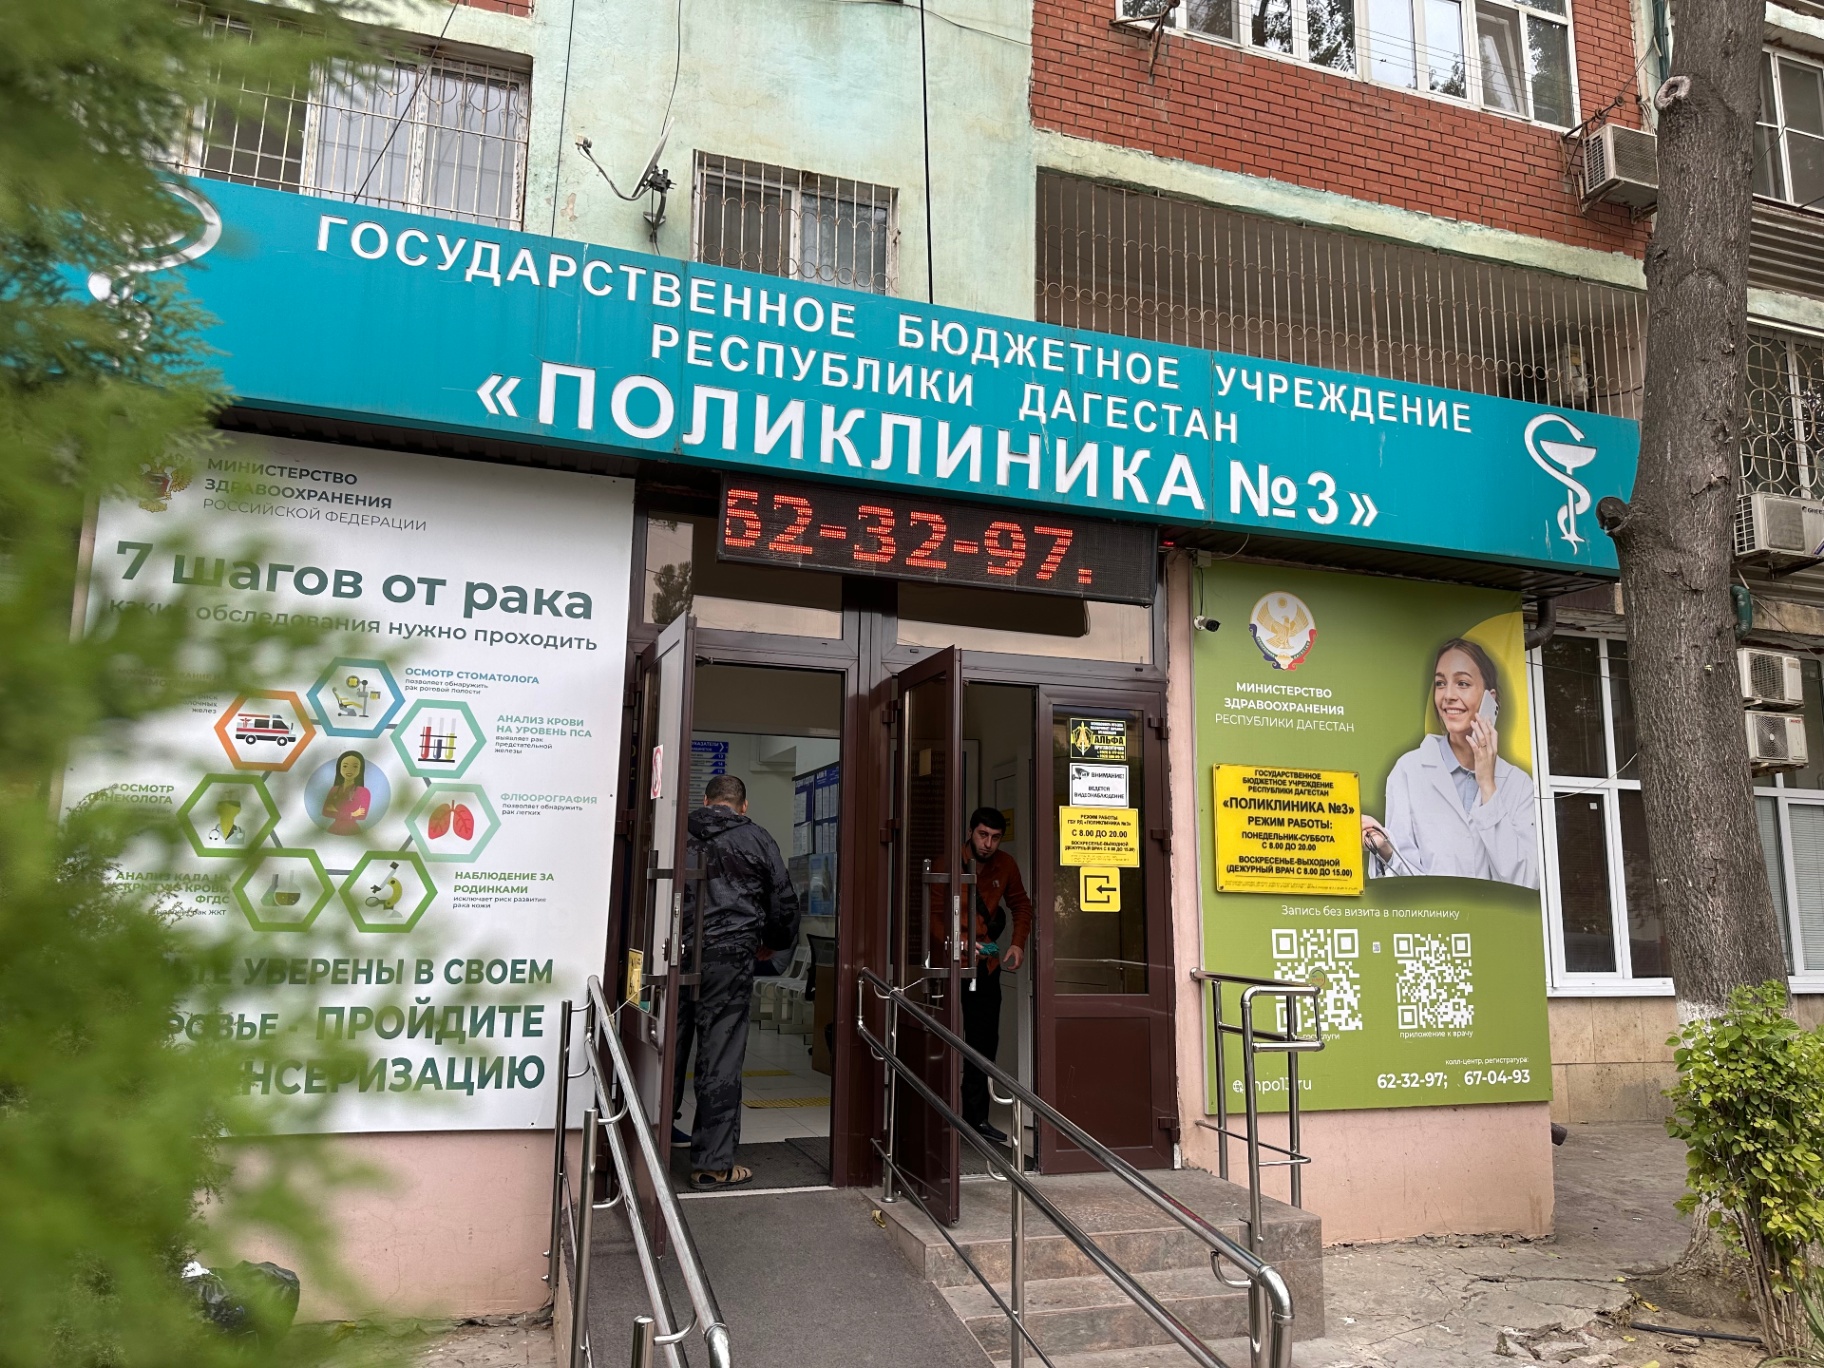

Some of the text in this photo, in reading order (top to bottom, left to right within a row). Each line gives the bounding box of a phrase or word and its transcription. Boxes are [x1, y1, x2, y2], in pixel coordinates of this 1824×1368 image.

[317, 213, 1473, 434] ГОСУДАРСТВЕННОЕ БЮДЖЕТНОЕ УЧРЕЖДЕНИЕ
[651, 322, 1239, 445] РЕСПУБЛИКИ ДАГЕСТАН
[476, 361, 1206, 511] «ПОЛИКЛИНИКА
[207, 457, 358, 486] МИНИСТЕРСТВО
[204, 477, 392, 509] ЗДРАВООХРАНЕНИЯ
[203, 497, 428, 532] РОССИЙСКОЙ ФЕДЕРАЦИИ
[116, 539, 593, 620] 7 шагов от рака
[196, 603, 381, 634] обследования
[388, 621, 467, 640] нужно
[474, 628, 598, 651] проходить
[405, 667, 540, 684] ОСМОТР СТОМАТОЛОГА
[404, 684, 418, 692] рак
[1236, 681, 1332, 698] МИНИСТЕРСТВО
[1223, 697, 1345, 715] ЗДРАВООХРАНЕНИЯ
[497, 714, 584, 727] АНАЛИЗ КРОВИ
[1215, 713, 1355, 732] РЕСПУБЛИКИ ДАГЕСТАН
[496, 725, 592, 738] НА УРОВЕНЬ ПСА
[1094, 735, 1124, 745] АЛЬФА
[1254, 769, 1322, 780] ГОСУДАРСТВЕННОЕ
[120, 783, 175, 794] ОСМОТР
[1242, 777, 1334, 789] БЮДЖЕТНОЕ УЧРЕЖДЕНИЕ
[500, 792, 598, 804] ФЛЮОРОГРАФИЯ
[1248, 786, 1329, 797] РЕСПУБЛИКИ ДАГЕСТАН
[99, 793, 173, 804] НЕКОЛОГА
[1222, 796, 1355, 815] «ПОЛИКЛИНИКА №3»
[1247, 816, 1333, 829] РЕЖИМ РАБОТЫ:
[1071, 829, 1128, 838] С 8.00 ДО 20.00
[1241, 831, 1335, 843] ПОНЕДЕЛЬНИК-СУББОТА
[1261, 841, 1317, 851] С 8.00 ДО 20.00
[1238, 855, 1340, 867] ВОСКРЕСЕНЬЕ-ВЫХОДНОЙ
[115, 871, 171, 881] АНАЛИЗ
[454, 871, 555, 882] НАБЛЮДЕНИЕ ЗА
[1226, 864, 1353, 878] (ДЕЖУРНЫЙ ВРАЧ С 8.00 ДО 15.00)
[453, 884, 528, 895] РОДИНКАМИ
[195, 895, 230, 905] ФГДС
[1281, 904, 1460, 920] Запись без визита в поликлинику
[243, 957, 404, 985] УВЕРЕНЫ
[414, 958, 434, 985] В
[443, 958, 554, 985] СВОЕМ
[166, 1012, 279, 1041] РОВЬЕ
[315, 995, 545, 1046] ПРОЙДИТЕ
[1400, 1031, 1446, 1040] приложение
[1452, 1030, 1474, 1038] врачу
[241, 1053, 546, 1097] НСЕРИЗАЦИЮ
[1376, 1068, 1531, 1089] 62-32-97; 67-04-93
